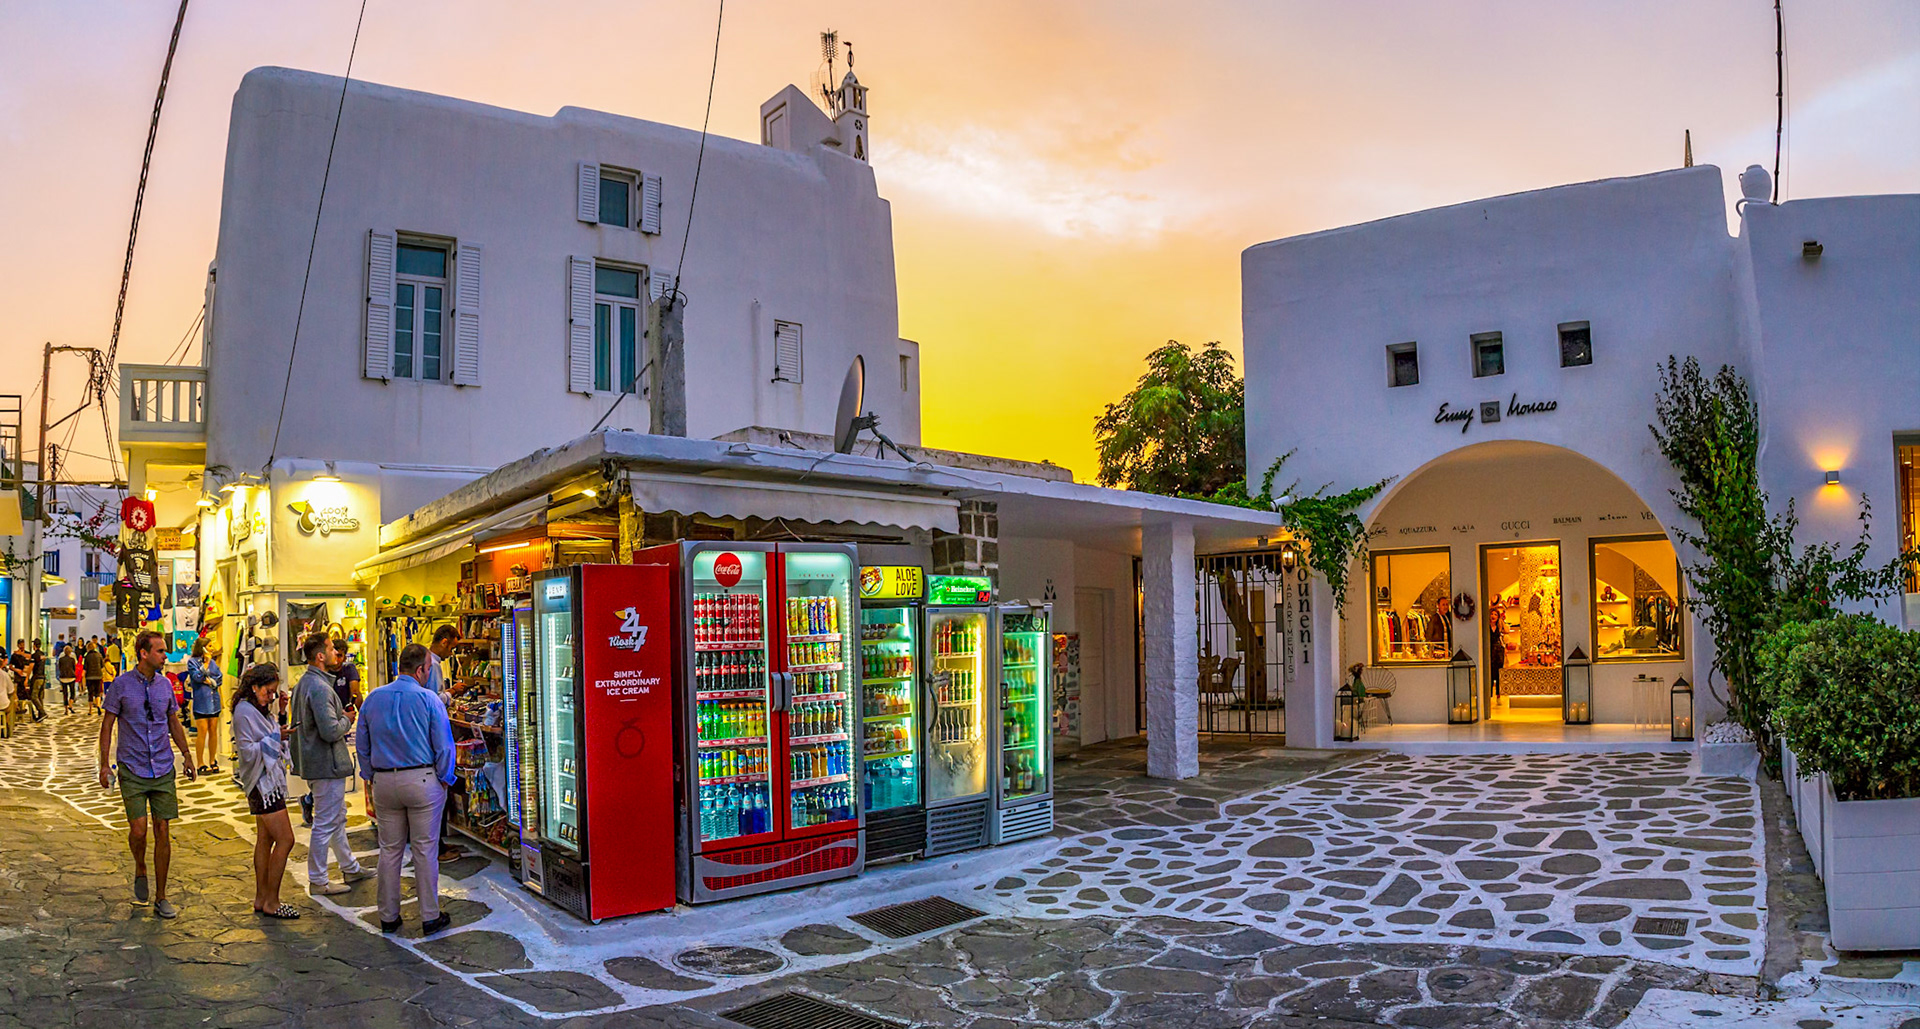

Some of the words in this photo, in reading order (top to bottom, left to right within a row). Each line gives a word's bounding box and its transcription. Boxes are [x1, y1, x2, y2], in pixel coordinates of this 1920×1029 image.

[1507, 393, 1558, 417] Monaco
[1553, 515, 1582, 524] BALMAIN
[1399, 525, 1438, 535] AQUAZZURA
[1501, 520, 1530, 531] GUCCI
[714, 563, 741, 575] Coca-Cola
[895, 568, 917, 582] ALOE
[895, 582, 917, 596] LOVE
[608, 636, 635, 647] Kiosk
[614, 670, 643, 679] SIMPLY
[595, 677, 661, 688] EXTRAORDINARY
[606, 688, 621, 696] ICE
[622, 686, 650, 695] CREAM
